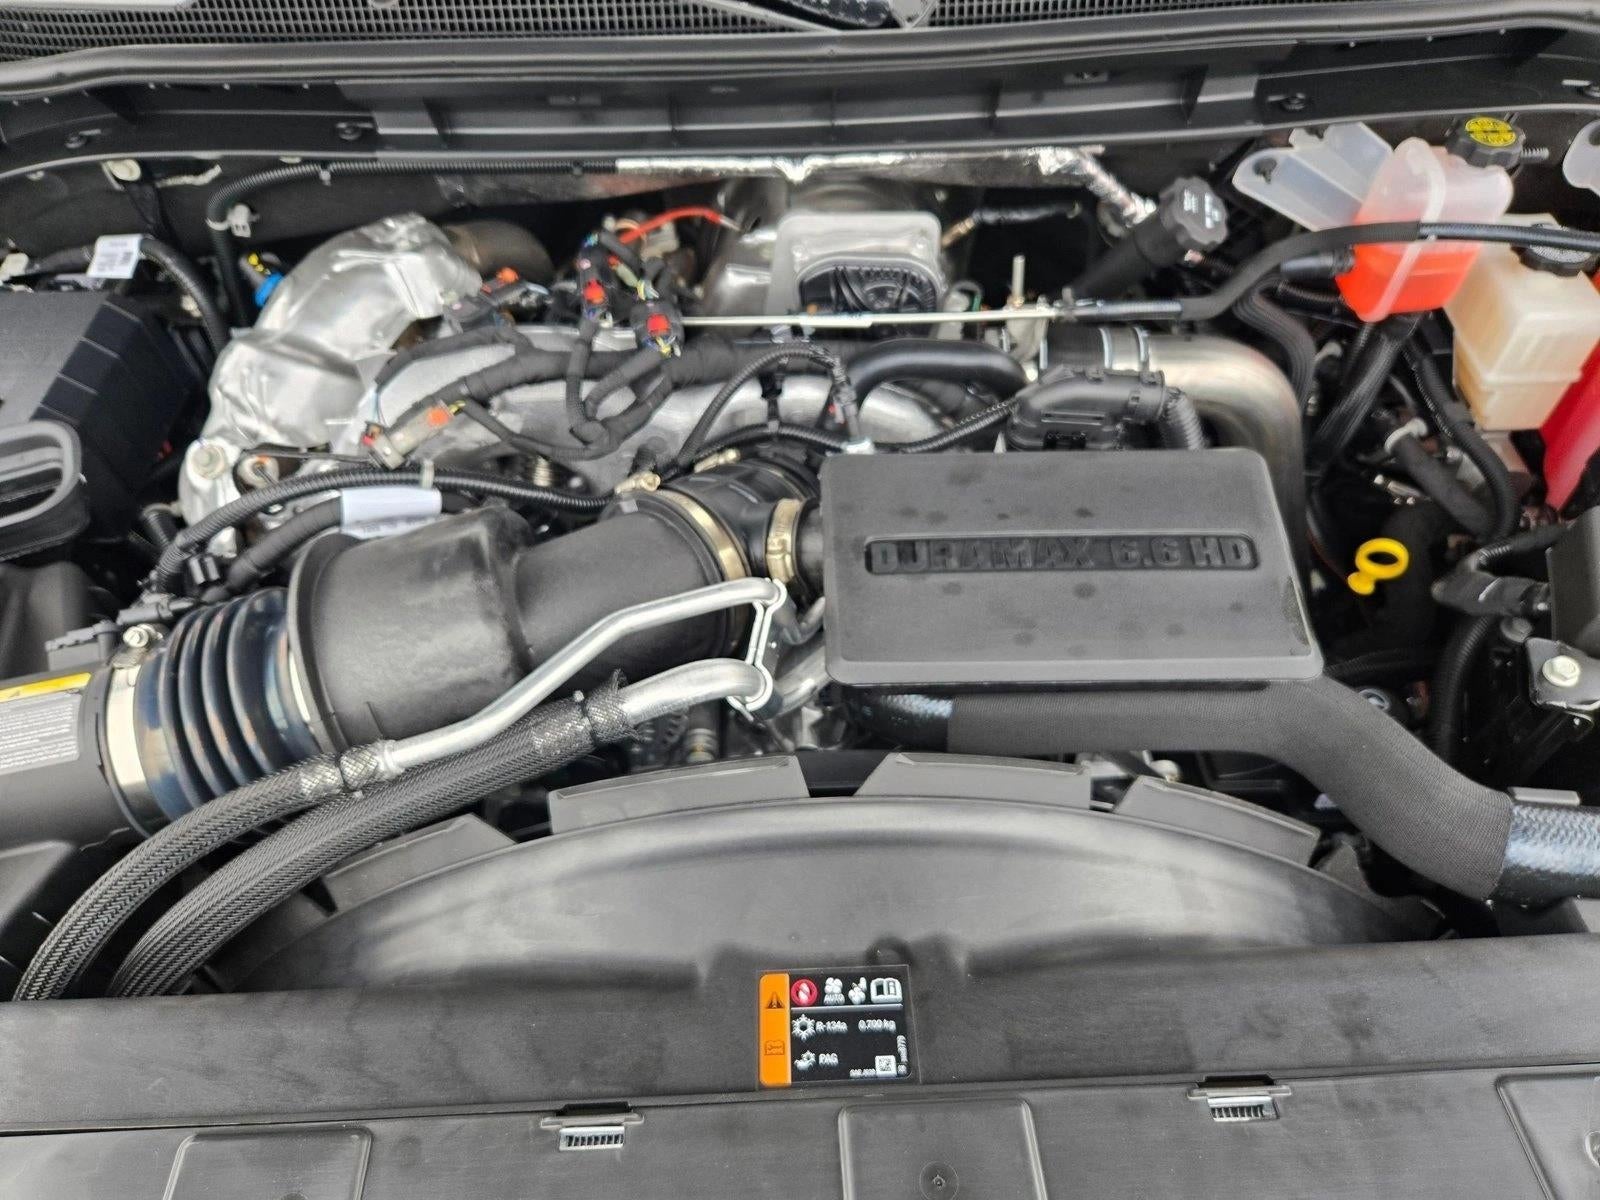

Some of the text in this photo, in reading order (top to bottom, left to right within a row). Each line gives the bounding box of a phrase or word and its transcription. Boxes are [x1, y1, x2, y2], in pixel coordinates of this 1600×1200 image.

[869, 535, 1253, 572] DURAMAX 6.6 HD
[818, 1053, 839, 1066] PAG
